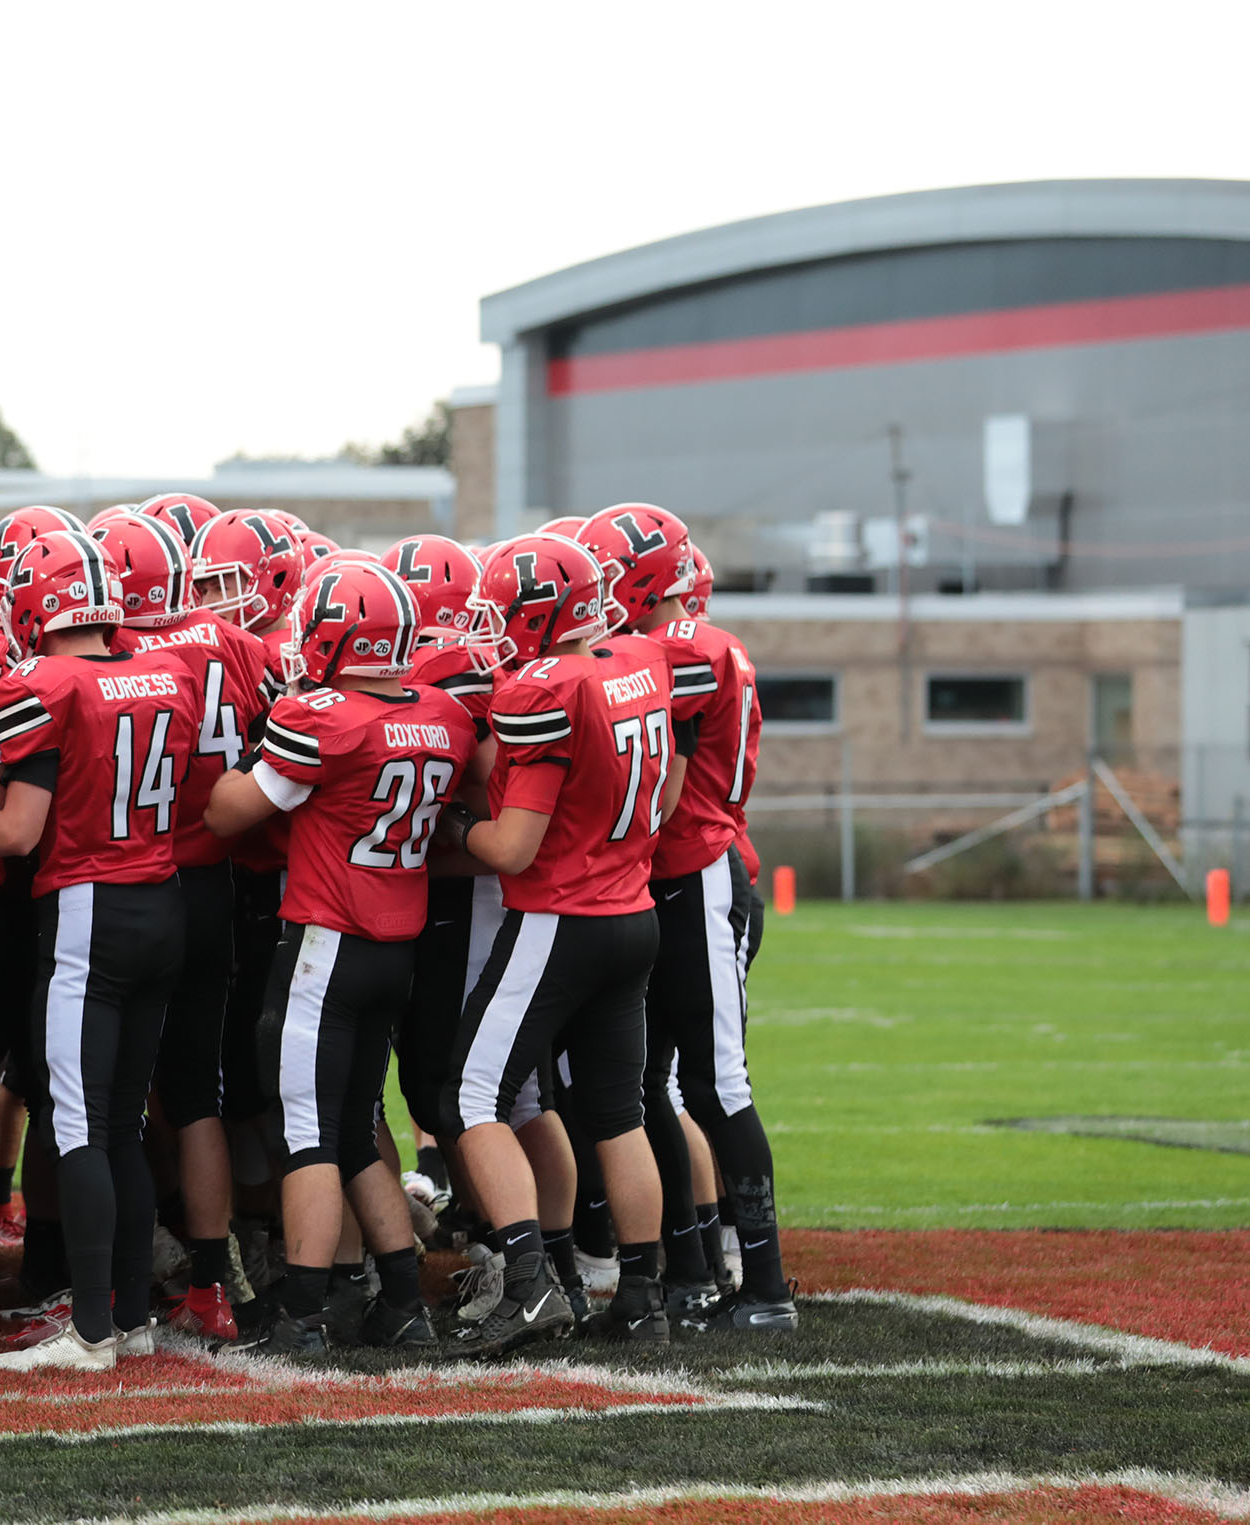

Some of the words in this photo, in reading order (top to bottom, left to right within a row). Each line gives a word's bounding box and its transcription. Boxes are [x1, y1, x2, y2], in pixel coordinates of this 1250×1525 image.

[241, 516, 294, 560] L
[611, 512, 668, 559] L
[396, 541, 432, 584] L
[72, 585, 85, 596] 14
[513, 552, 558, 605] L
[45, 597, 57, 609] JP
[126, 596, 140, 607] JP
[150, 590, 163, 601] 54
[312, 574, 346, 623] L
[72, 609, 121, 624] Riddell
[439, 611, 451, 622] JP
[456, 614, 468, 626] 77
[575, 605, 587, 616] JP
[134, 623, 221, 654] JELONEK
[666, 621, 697, 640] 19
[356, 641, 369, 653] JP
[376, 643, 389, 654] 26
[97, 673, 179, 701] BURGESS
[298, 687, 347, 711] 26
[602, 668, 658, 706] PRESCOTT
[384, 723, 451, 750] COXFORD
[110, 709, 178, 842] 14
[607, 707, 670, 842] 72
[347, 758, 455, 870] 26
